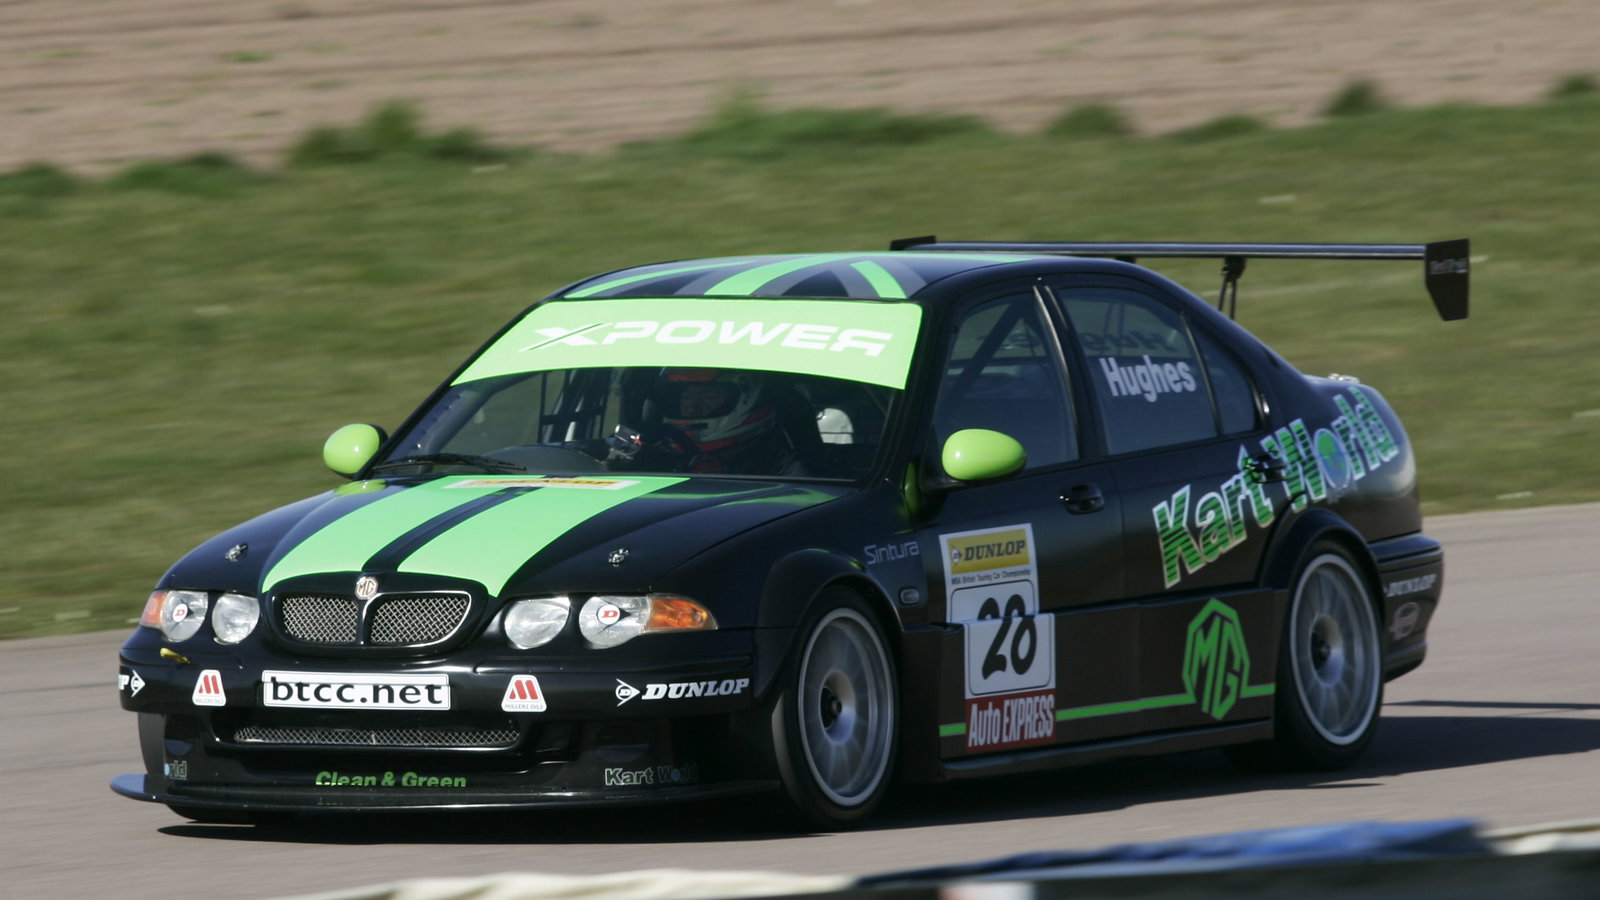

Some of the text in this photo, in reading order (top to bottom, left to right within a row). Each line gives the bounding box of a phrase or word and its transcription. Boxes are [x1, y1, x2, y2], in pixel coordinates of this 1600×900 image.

[518, 320, 893, 357] XPOWER
[1100, 355, 1197, 402] Hughes
[1152, 386, 1399, 590] Kart World
[864, 541, 921, 566] Sintura
[964, 540, 1026, 562] DUNLOP
[357, 578, 376, 597] MG
[978, 593, 1038, 681] 28
[1189, 608, 1244, 721] MG
[270, 676, 443, 705] btcc.net
[641, 678, 750, 700] DUNLOP
[968, 694, 1056, 748] Auto EXPRESS
[315, 771, 467, 788] Clean & Green
[605, 766, 653, 786] Kart
